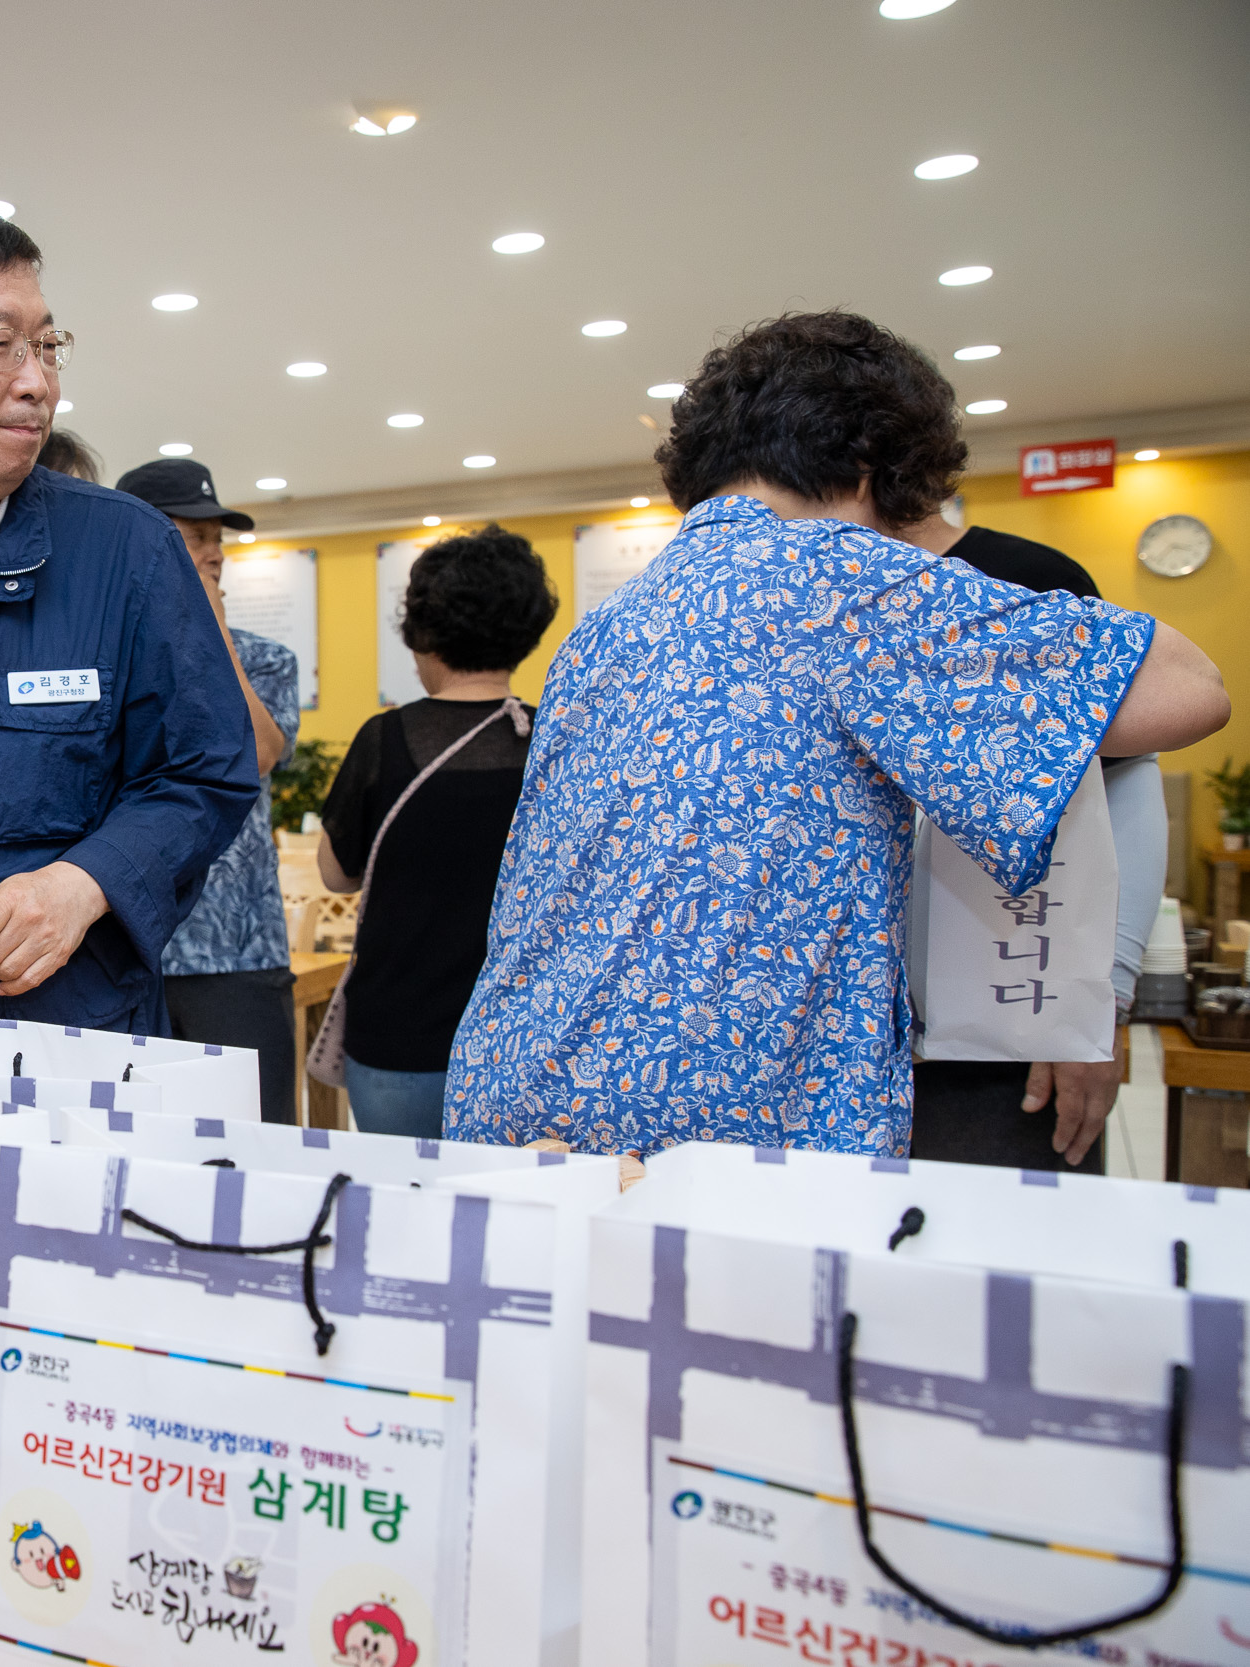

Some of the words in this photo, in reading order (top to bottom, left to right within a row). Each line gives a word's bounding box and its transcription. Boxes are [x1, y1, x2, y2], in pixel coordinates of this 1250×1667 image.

[47, 688, 85, 697] 광진구청장
[990, 857, 1065, 1015] 합니다
[65, 1400, 116, 1431] 중곡4동
[126, 1411, 290, 1460] 지역사회보장협의체와
[300, 1444, 372, 1480] 함께하는
[23, 1431, 227, 1507] 어르신건강기원
[247, 1466, 410, 1544] 삼계탕
[128, 1550, 215, 1594] 삼계탕
[708, 1595, 1008, 1667] 어르신건강
